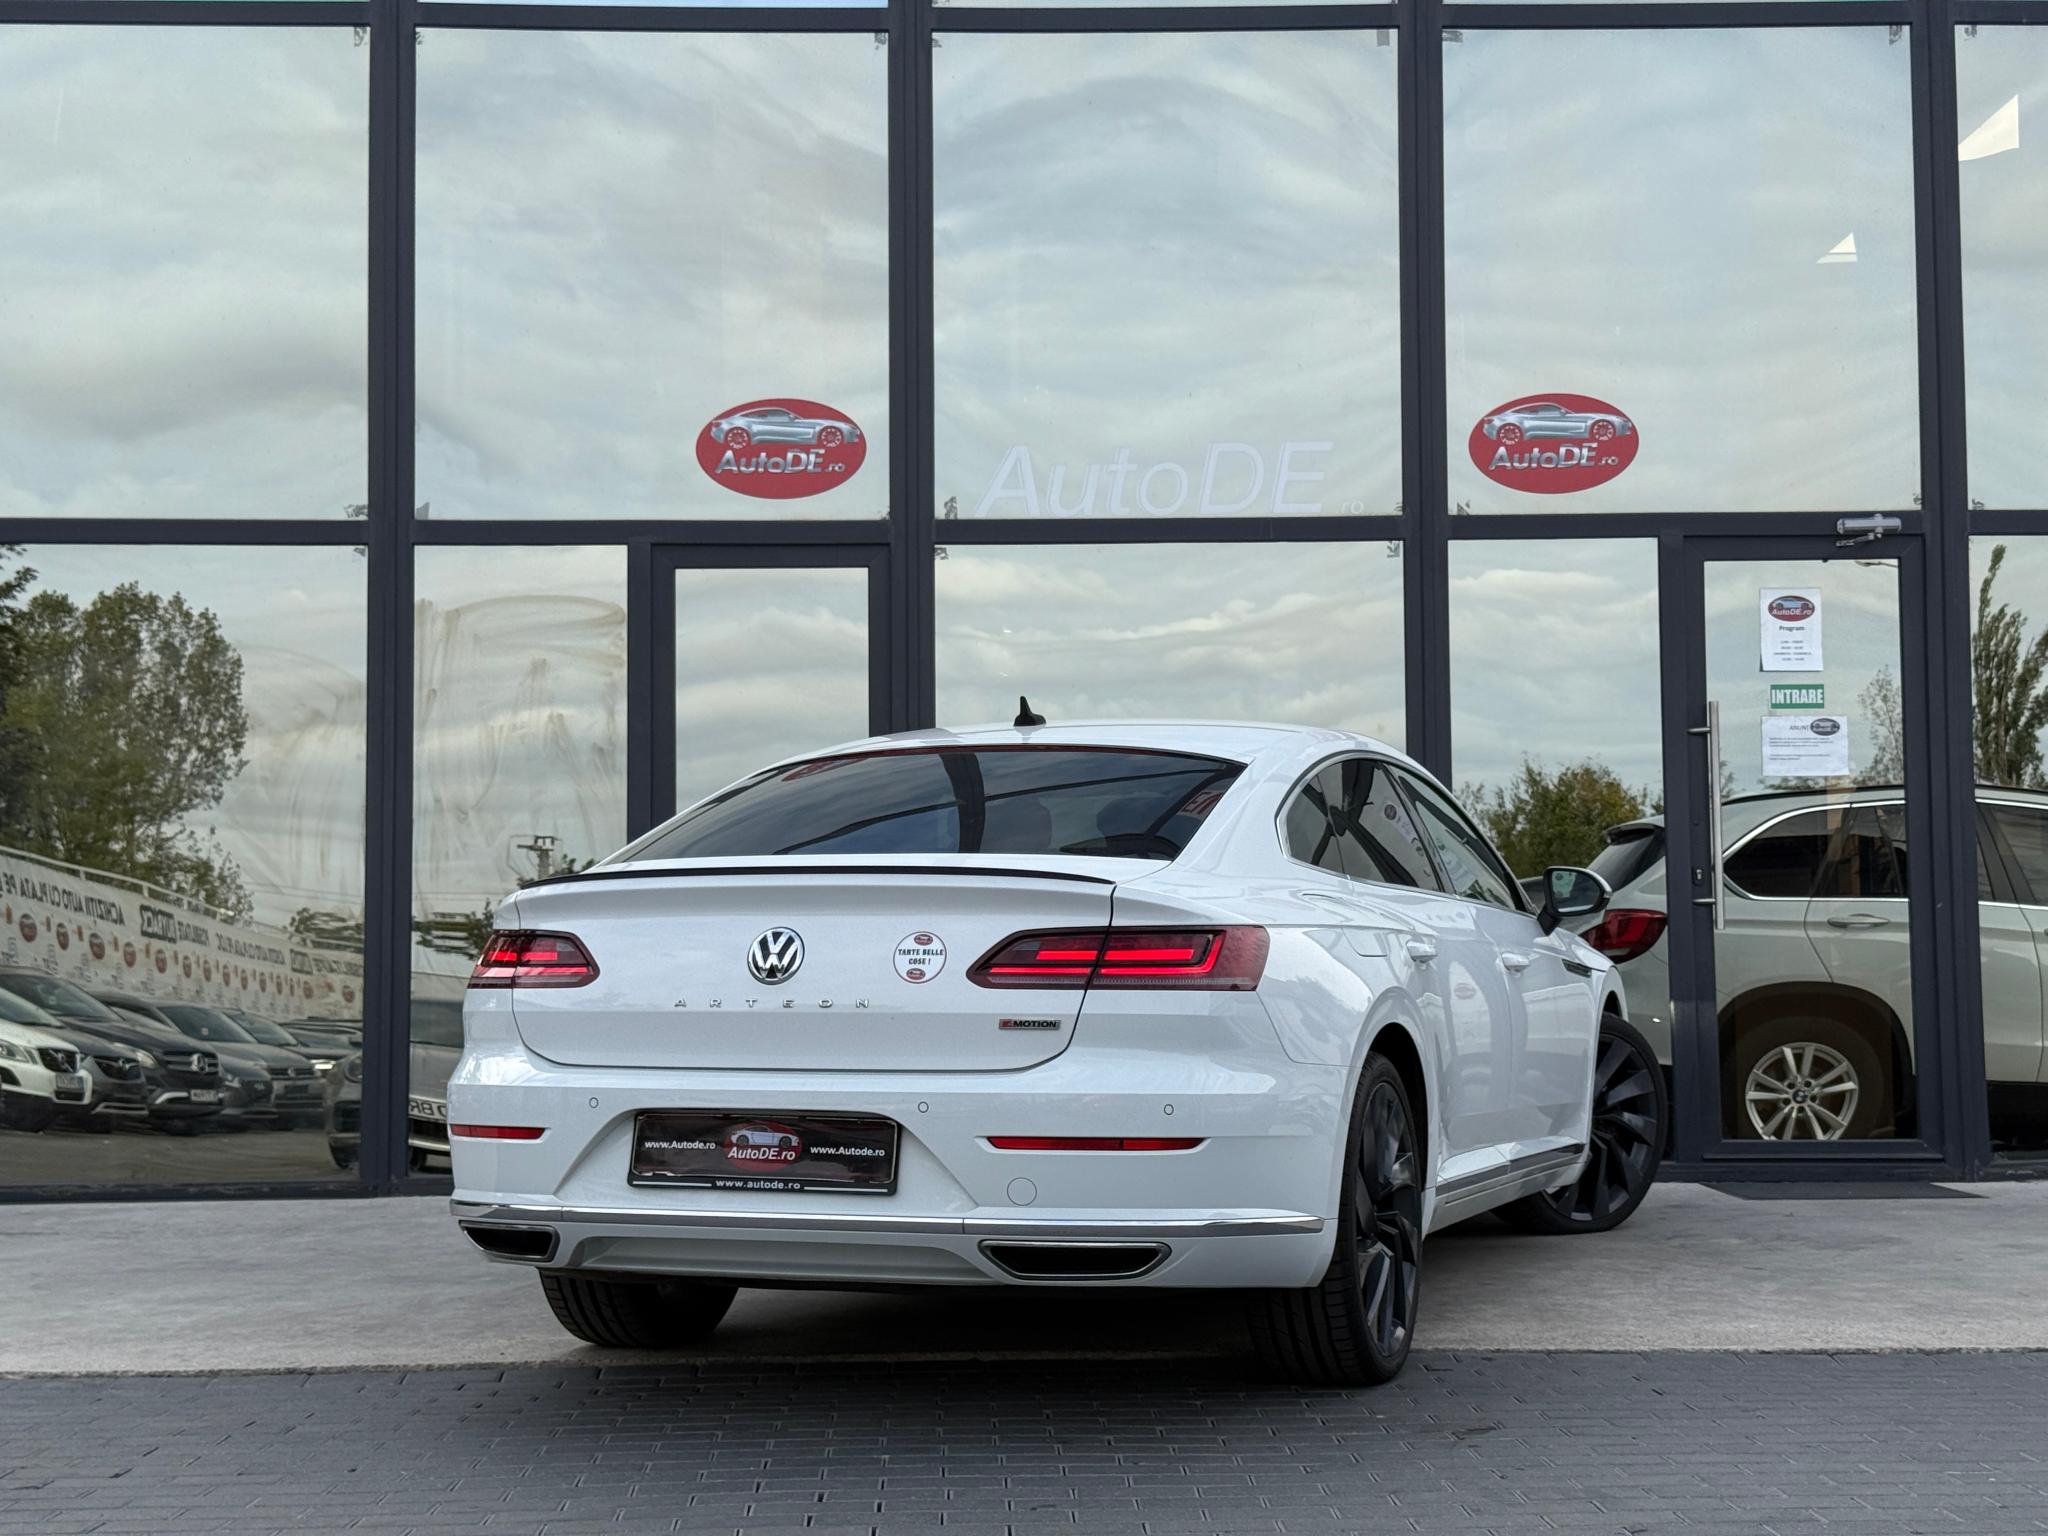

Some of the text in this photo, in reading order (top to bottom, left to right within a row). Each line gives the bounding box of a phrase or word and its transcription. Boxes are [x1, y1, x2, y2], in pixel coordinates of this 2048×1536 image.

[1771, 689, 1823, 704] INTRARE
[674, 998, 870, 1008] ARTEON
[644, 1140, 716, 1150] www.Autode.ro
[727, 1145, 796, 1161] AutoDE.ro
[810, 1145, 885, 1157] www.Autode.ro
[715, 1179, 801, 1190] www.autode.ro
